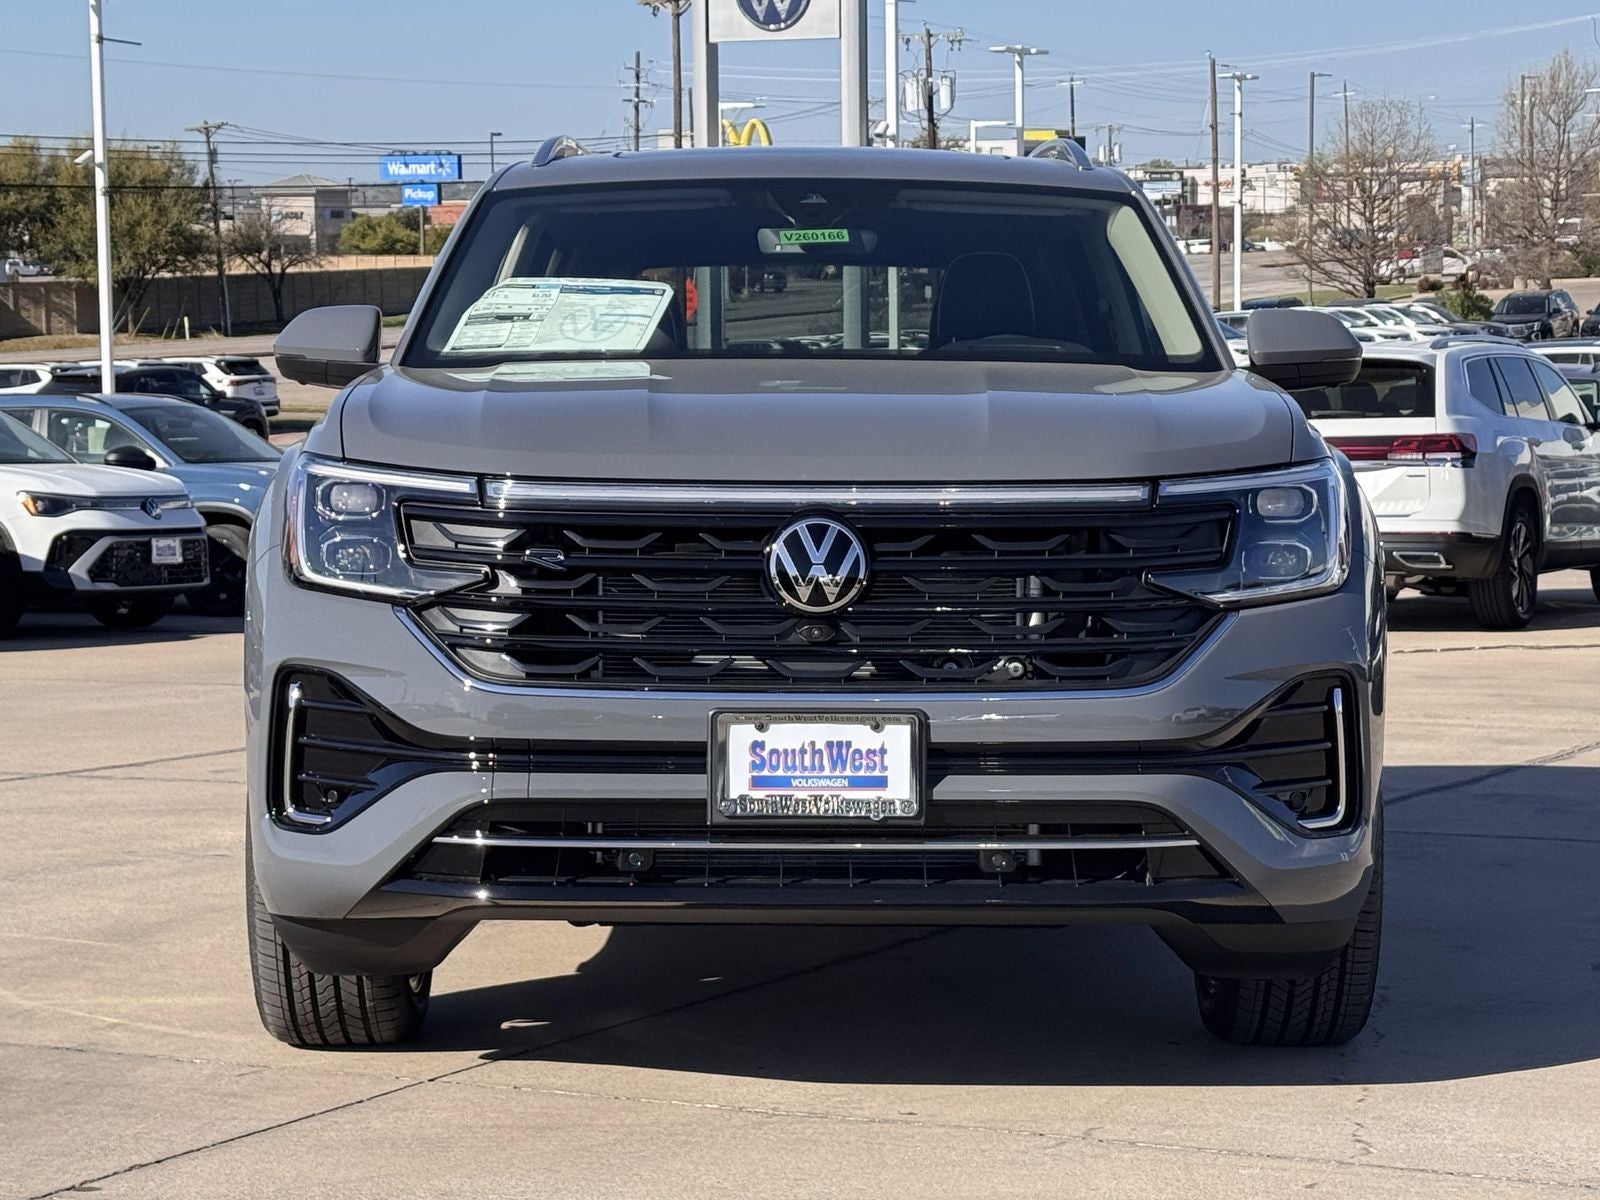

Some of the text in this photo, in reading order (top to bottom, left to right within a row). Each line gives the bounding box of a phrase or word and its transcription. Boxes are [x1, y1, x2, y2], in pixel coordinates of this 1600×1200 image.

[404, 188, 434, 201] Pickup
[783, 231, 845, 242] V260166
[748, 739, 888, 774] SouthWest
[791, 777, 849, 788] VOLKSWAGEN
